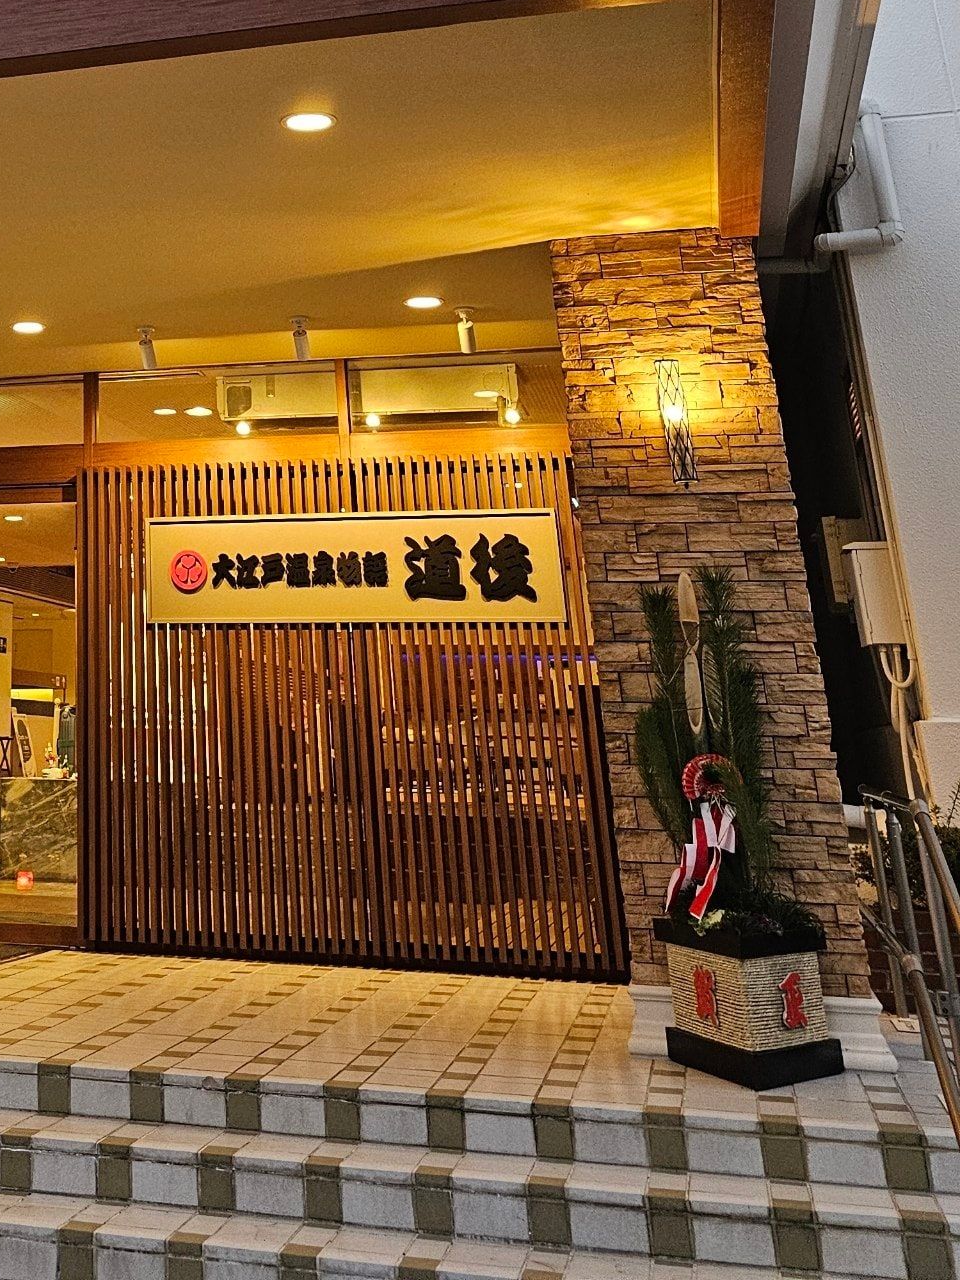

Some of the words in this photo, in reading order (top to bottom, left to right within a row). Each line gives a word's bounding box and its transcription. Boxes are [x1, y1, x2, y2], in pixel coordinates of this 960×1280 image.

[212, 550, 389, 589] 大江戸温泉物語
[404, 533, 538, 603] 道後
